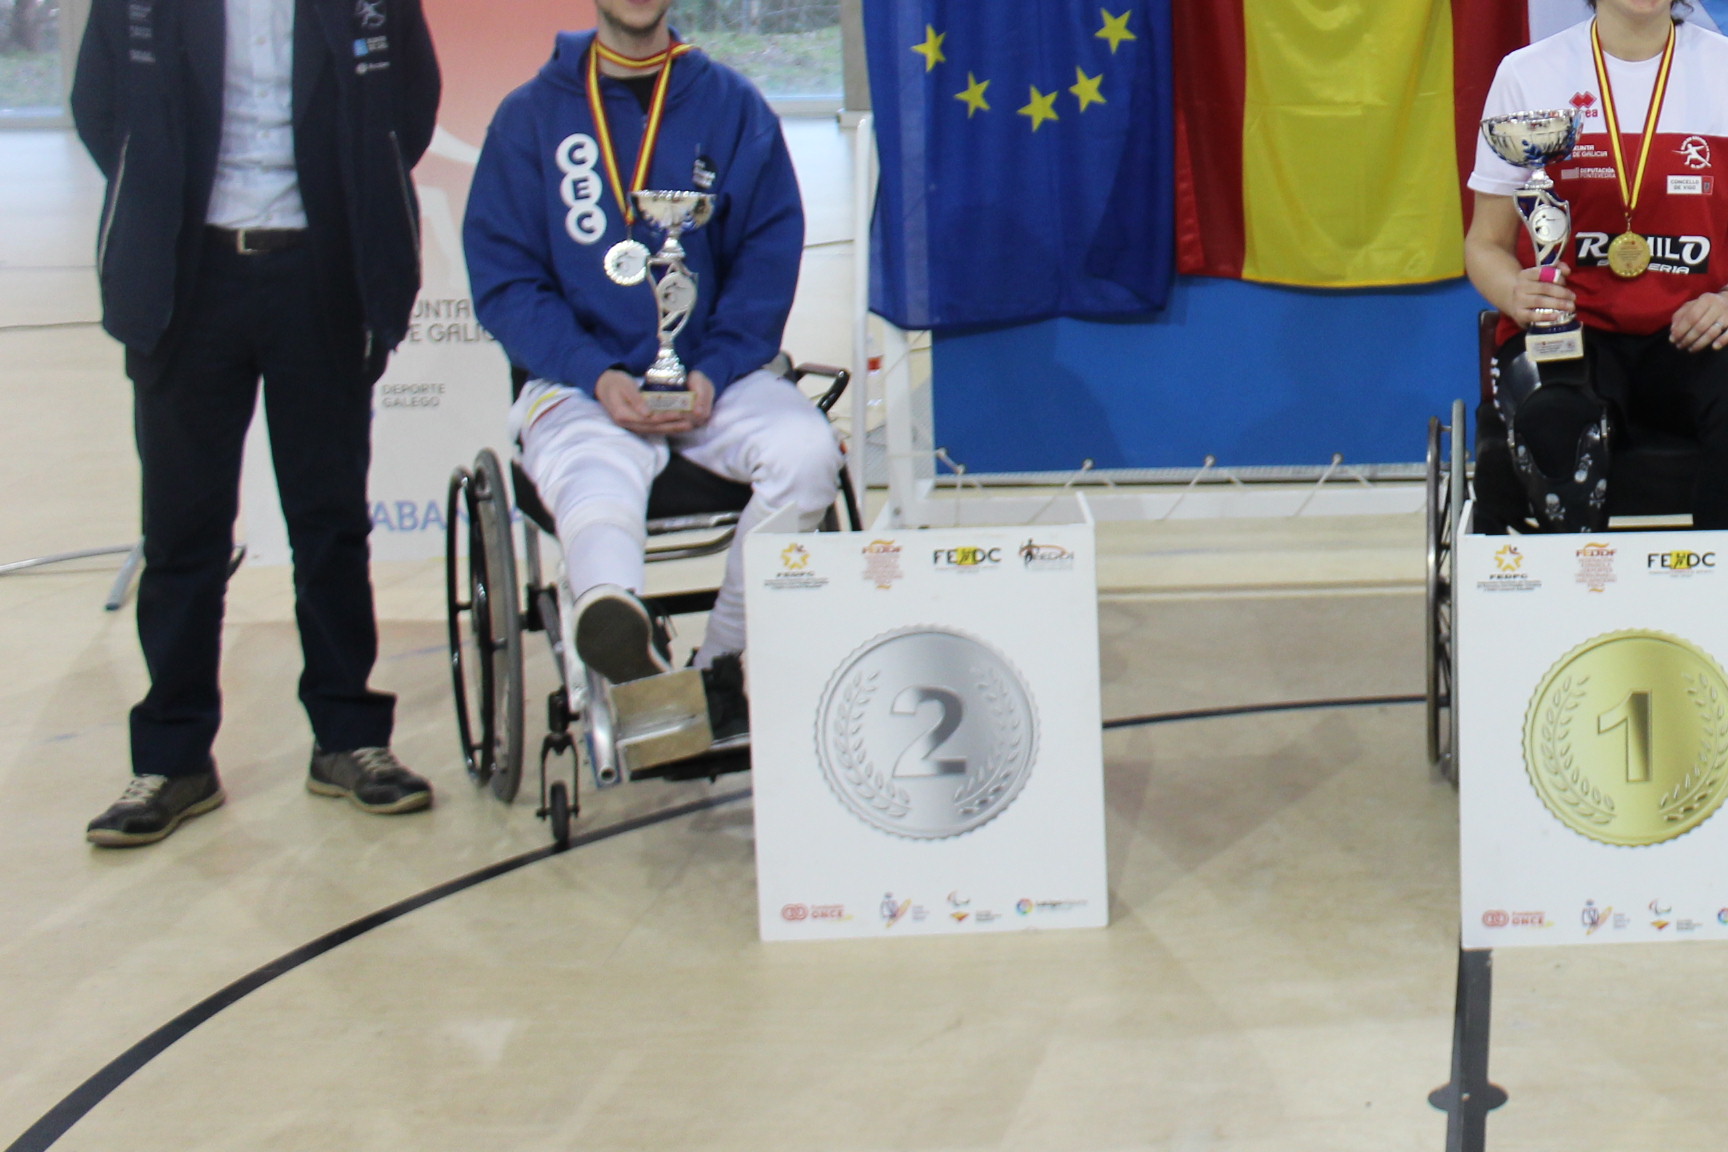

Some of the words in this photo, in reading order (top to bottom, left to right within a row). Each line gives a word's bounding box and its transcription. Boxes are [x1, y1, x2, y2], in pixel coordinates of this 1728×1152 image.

[413, 300, 471, 319] UNTA
[382, 383, 446, 395] DEPORTE
[382, 397, 441, 408] GALEGO
[890, 685, 967, 779] 2
[1597, 688, 1652, 783] 1
